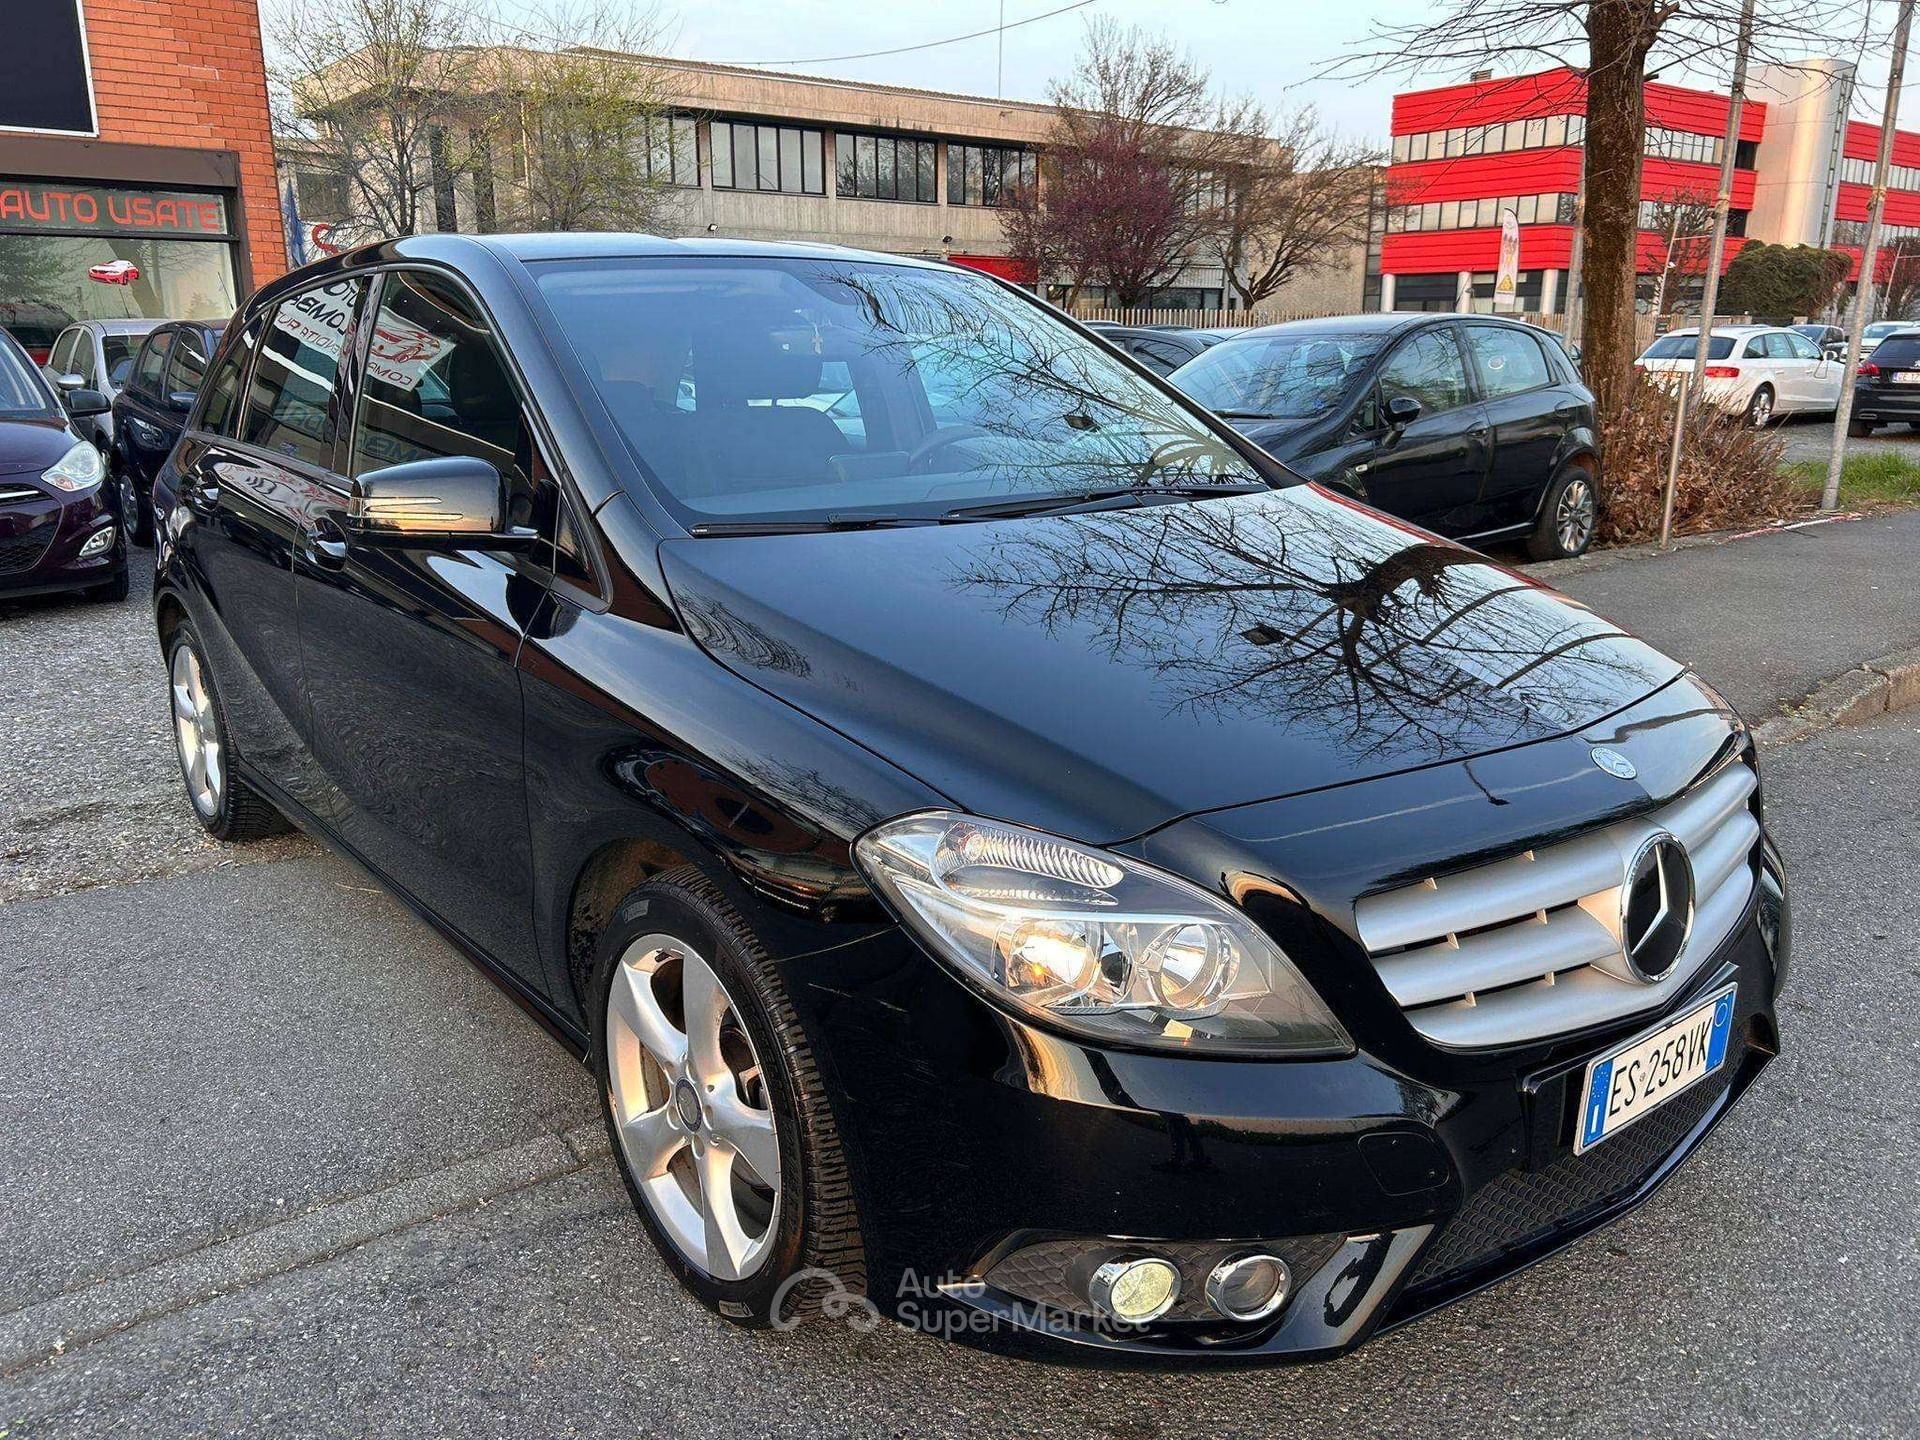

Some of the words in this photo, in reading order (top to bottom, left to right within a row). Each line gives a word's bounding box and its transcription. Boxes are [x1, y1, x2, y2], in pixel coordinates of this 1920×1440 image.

[0, 189, 98, 224] AUTO
[108, 195, 220, 231] USATE
[1609, 1060, 1641, 1117] ES
[1644, 1016, 1713, 1098] 258VK
